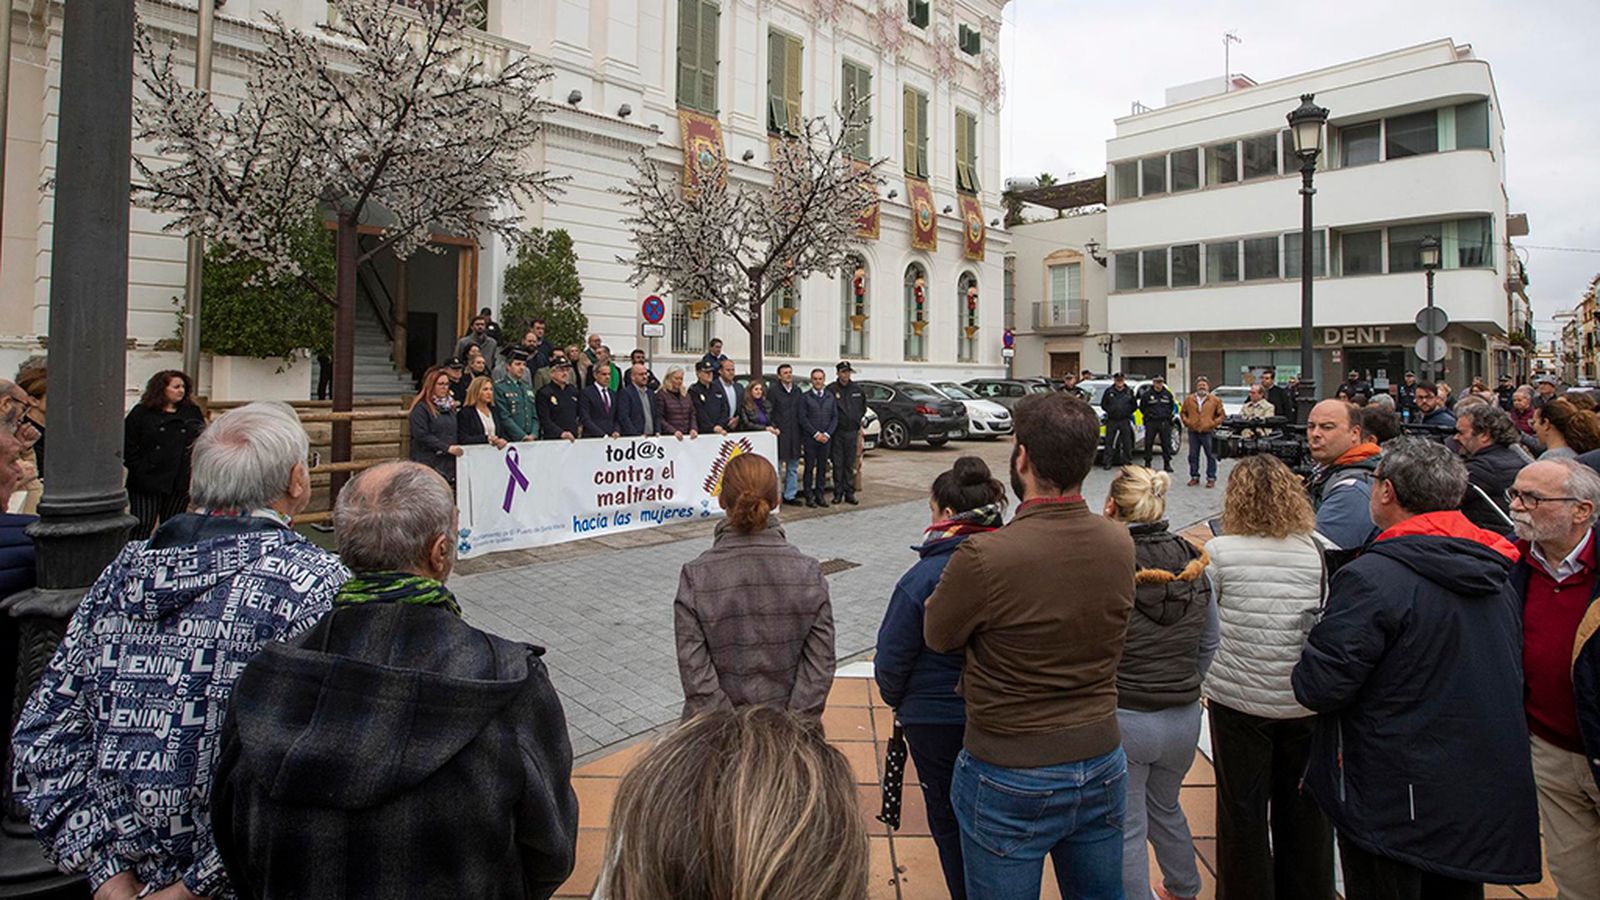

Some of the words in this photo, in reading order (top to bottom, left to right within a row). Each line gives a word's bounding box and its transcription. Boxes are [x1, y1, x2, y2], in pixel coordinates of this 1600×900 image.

[605, 441, 665, 462] tod@s
[594, 465, 654, 485] contra
[661, 460, 675, 480] el
[596, 484, 674, 507] maltrato
[573, 513, 608, 533] hacia
[613, 510, 632, 526] las
[640, 506, 694, 524] mujeres
[129, 751, 178, 772] JEANS
